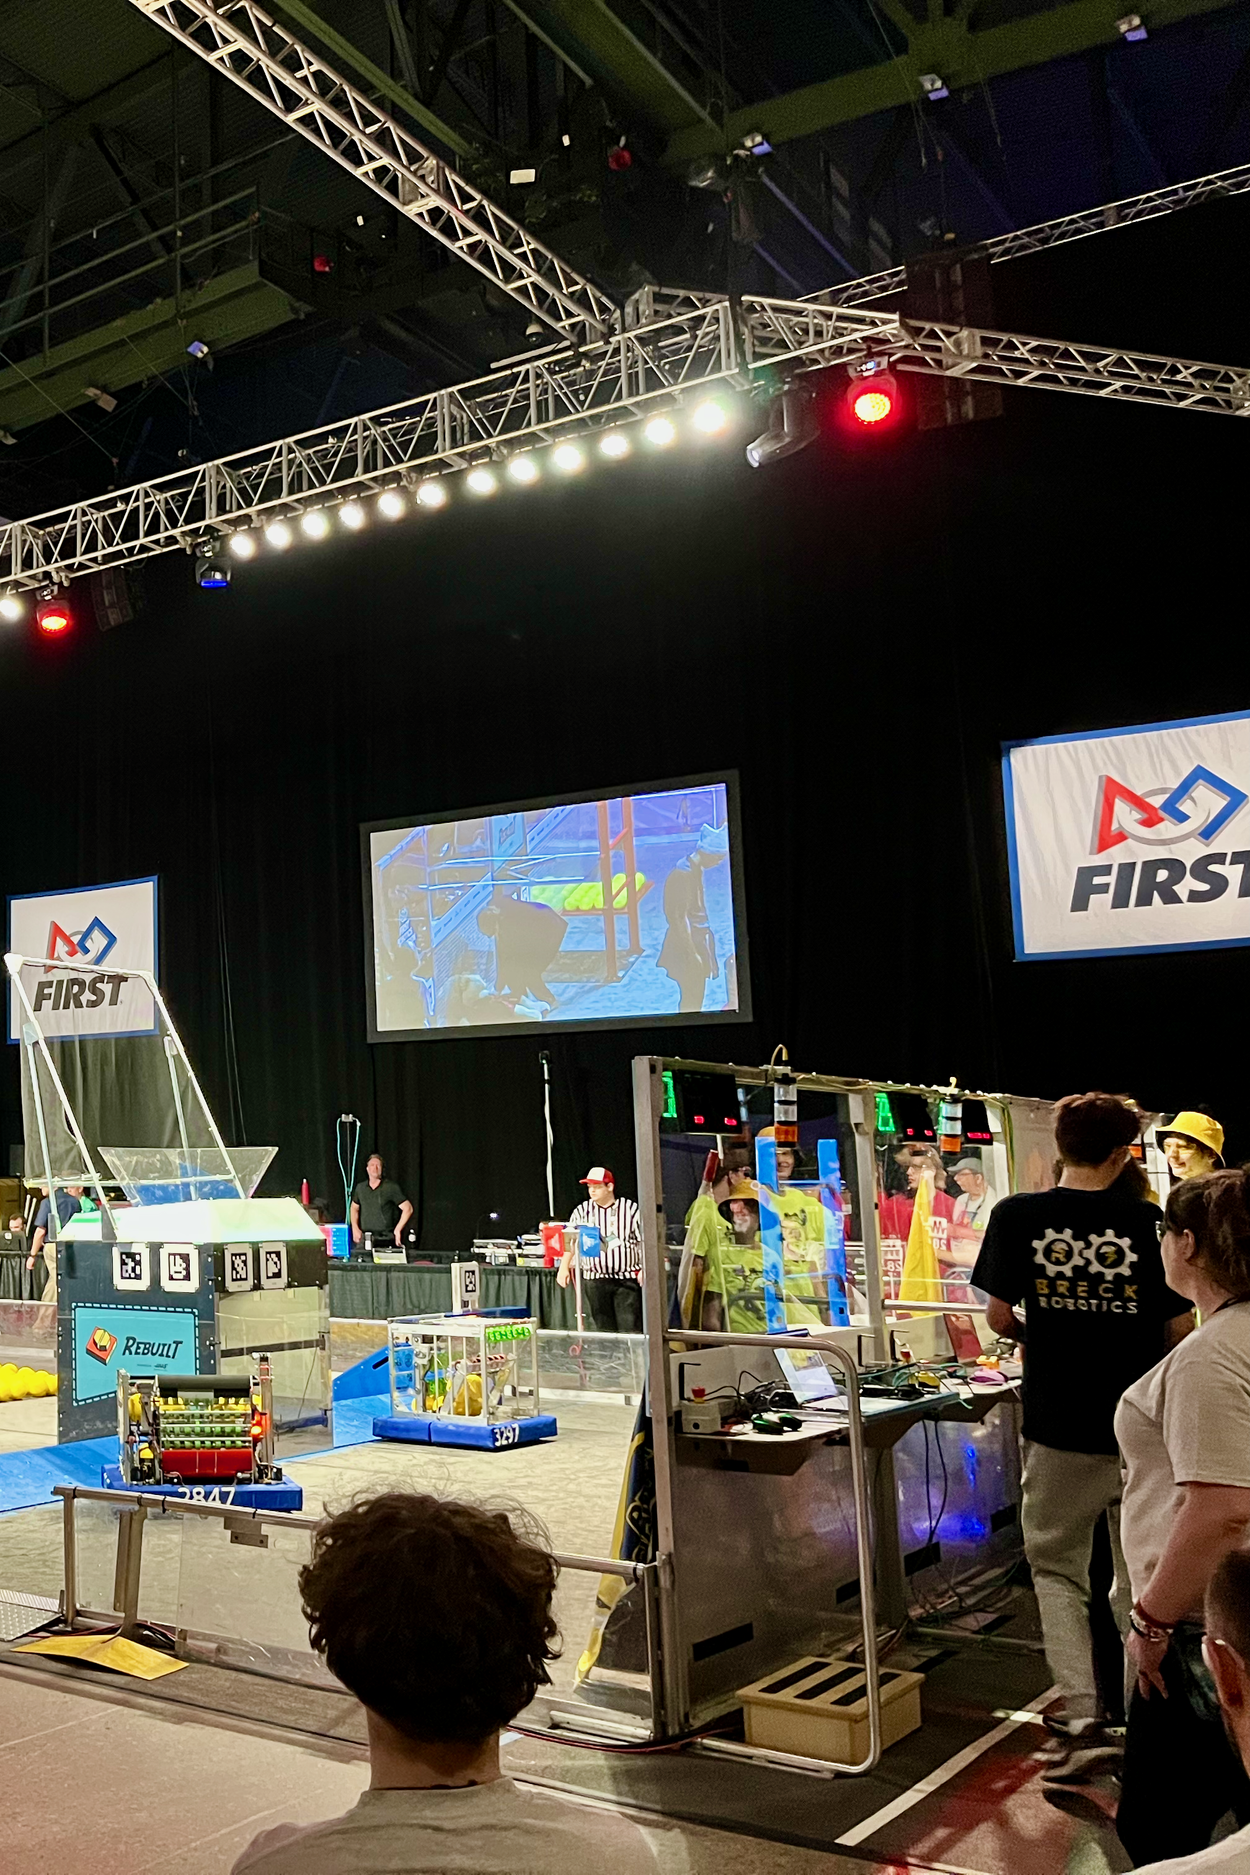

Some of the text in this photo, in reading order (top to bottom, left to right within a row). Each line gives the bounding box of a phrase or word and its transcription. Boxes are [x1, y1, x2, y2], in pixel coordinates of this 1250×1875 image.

[33, 974, 129, 1012] FIRST
[1035, 1279, 1139, 1300] BRECK
[1038, 1296, 1139, 1314] ROBOTICS
[122, 1336, 184, 1359] REBUILT
[493, 1423, 520, 1447] 3297
[177, 1486, 236, 1506] 2847
